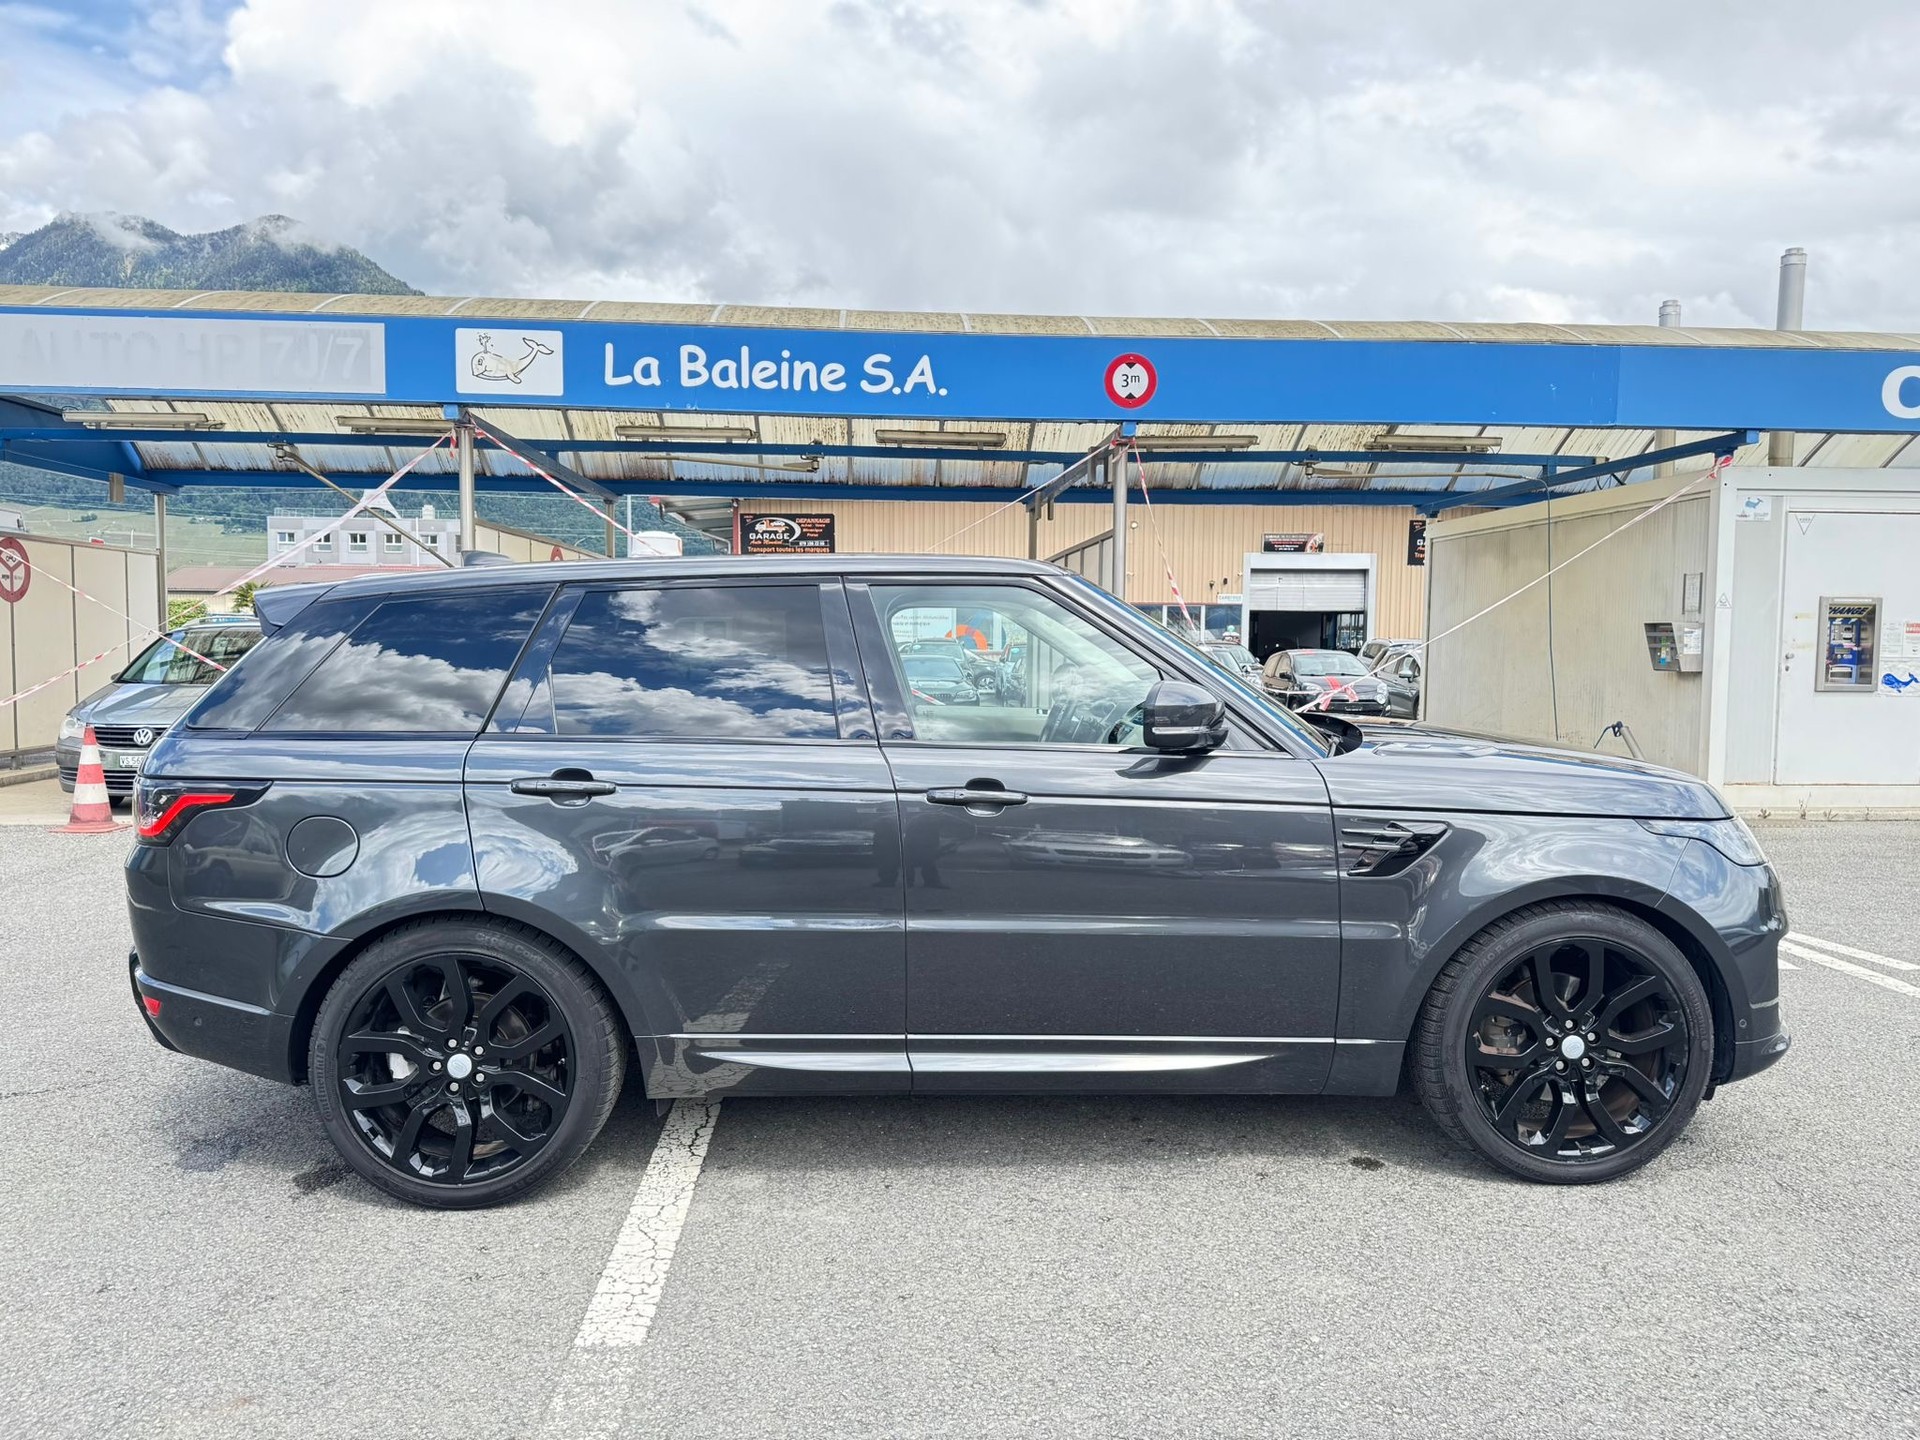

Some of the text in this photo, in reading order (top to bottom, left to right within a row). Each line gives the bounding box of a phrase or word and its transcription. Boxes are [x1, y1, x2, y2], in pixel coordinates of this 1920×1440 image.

[604, 342, 948, 397] La Baleine S.A.
[1121, 373, 1141, 388] 3m
